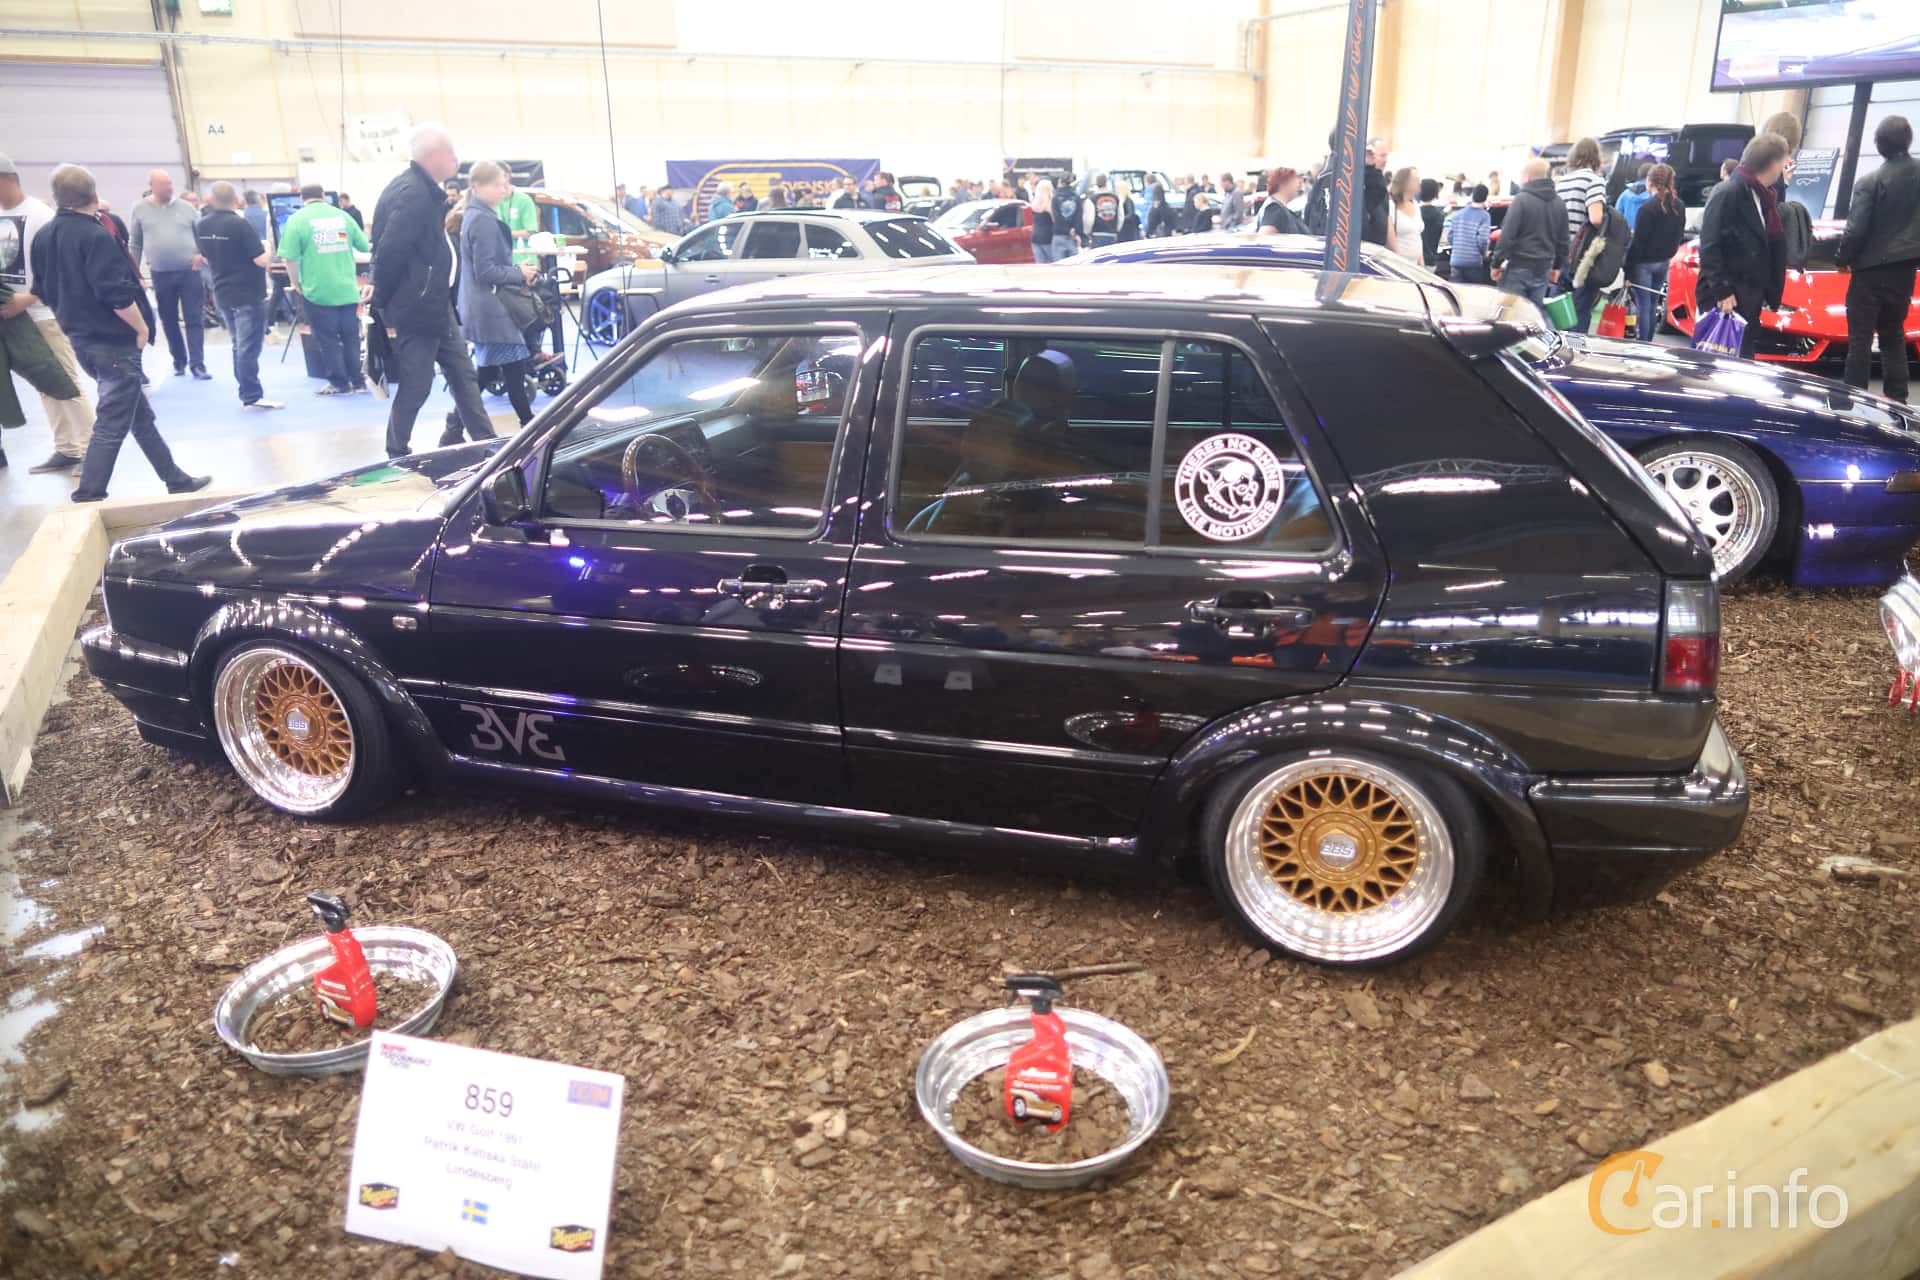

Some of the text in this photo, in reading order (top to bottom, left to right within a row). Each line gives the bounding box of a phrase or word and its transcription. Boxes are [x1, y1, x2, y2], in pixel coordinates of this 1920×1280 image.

[208, 124, 225, 135] A4
[1180, 437, 1280, 489] THERES NO SHINE
[1182, 498, 1277, 537] LIKE MOTHERS
[465, 1083, 514, 1118] 859
[447, 1120, 466, 1133] VW
[470, 1123, 494, 1138] Golf
[424, 1136, 459, 1152] Patrik
[445, 1163, 513, 1191] Lindesberg
